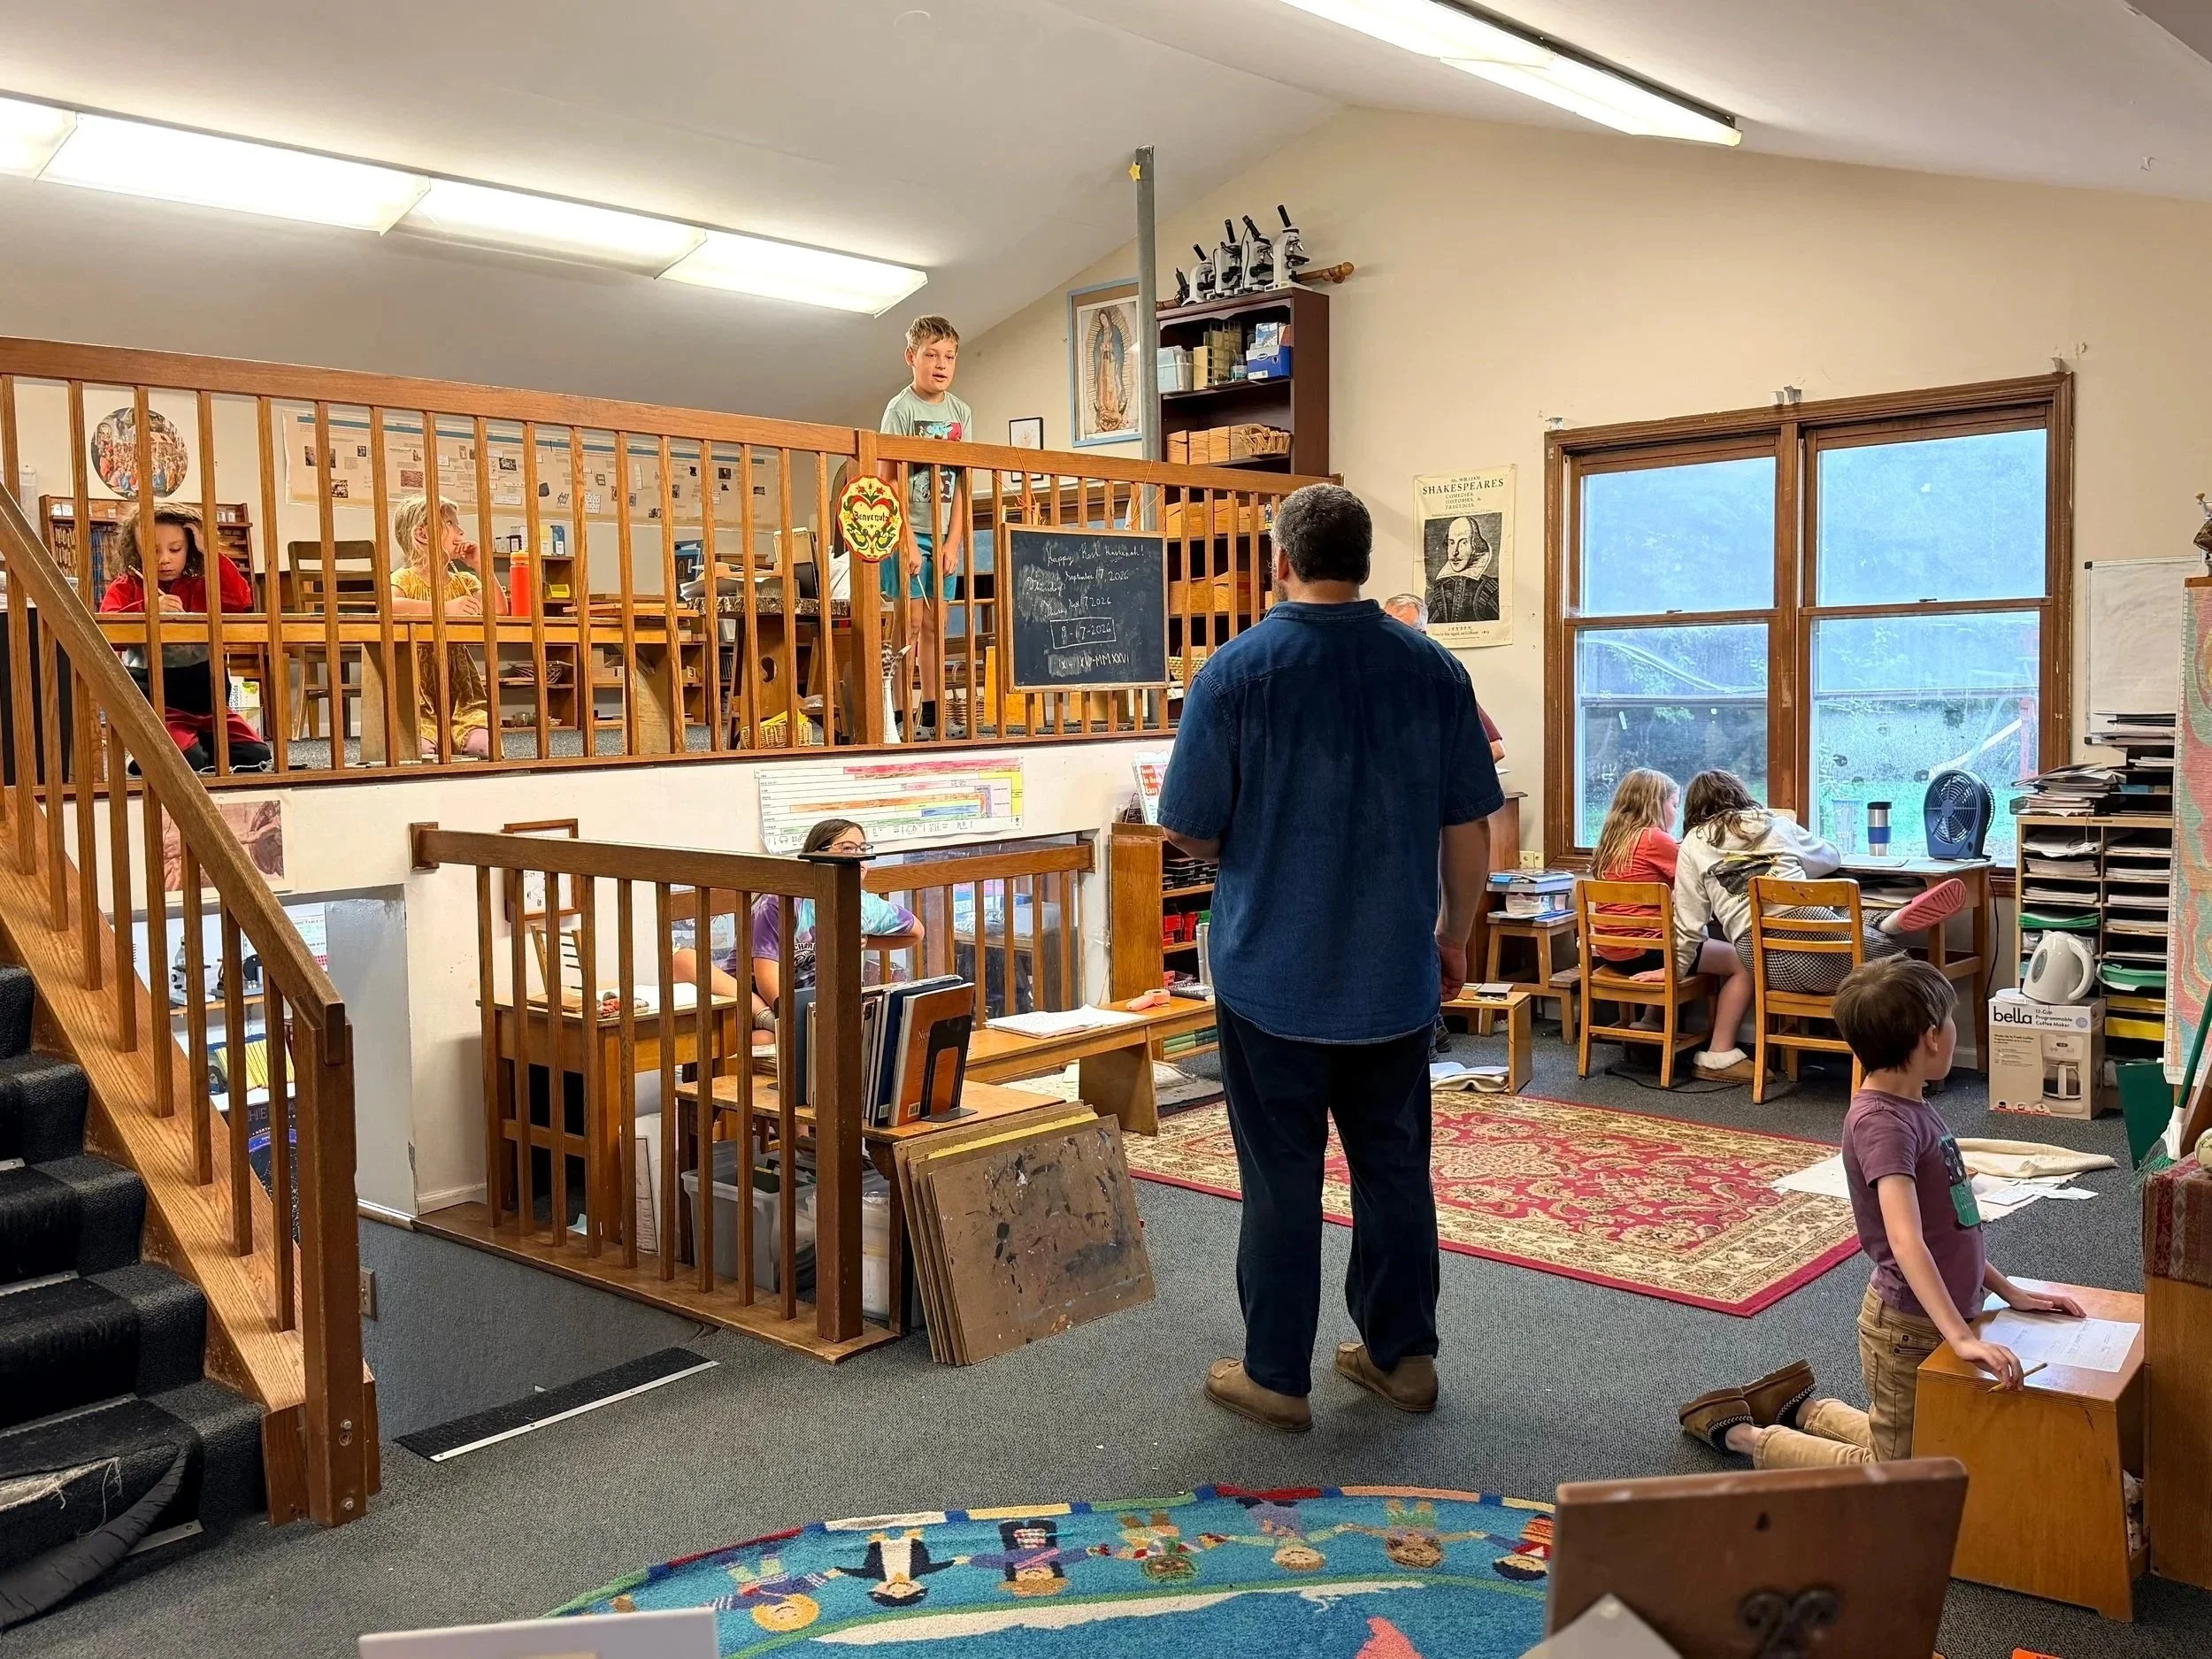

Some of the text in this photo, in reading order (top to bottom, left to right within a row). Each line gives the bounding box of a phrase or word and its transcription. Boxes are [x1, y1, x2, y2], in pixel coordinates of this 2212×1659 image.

[1422, 478, 1504, 495] SHAKESPEARES
[1045, 547, 1074, 567] Happy
[1079, 542, 1101, 560] Rosh
[1064, 571, 1094, 584] September
[1109, 571, 1130, 582] 2026
[1089, 596, 1112, 608] 2026
[688, 667, 695, 678] 3
[1993, 1005, 2032, 1025] bella
[248, 1106, 268, 1122] HE
